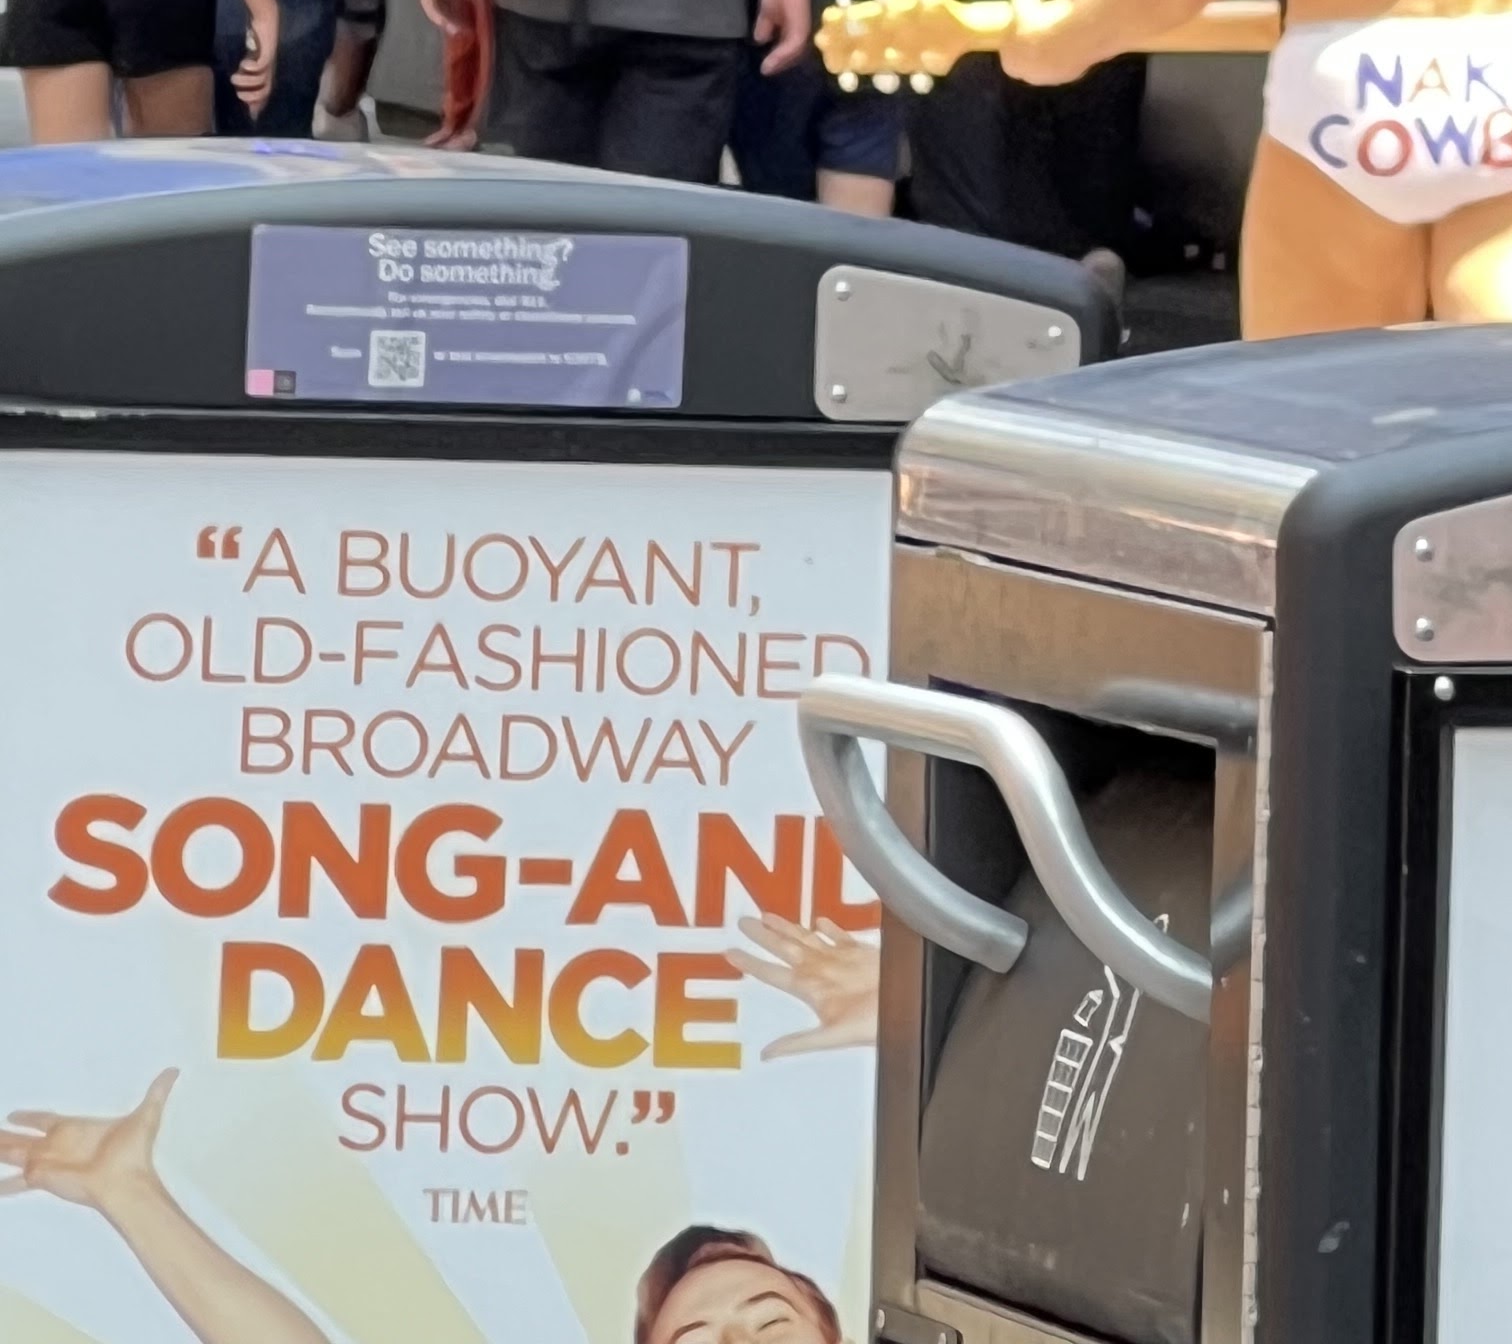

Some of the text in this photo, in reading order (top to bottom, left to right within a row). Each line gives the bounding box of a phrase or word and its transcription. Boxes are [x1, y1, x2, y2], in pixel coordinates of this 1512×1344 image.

[368, 232, 574, 266] See something?
[378, 258, 414, 282] Do
[337, 529, 762, 617] BUOYANT,
[125, 611, 872, 699] OLD-FASHIONED
[239, 705, 757, 786] BROADWAY
[216, 941, 744, 1070] DANCE
[338, 1082, 676, 1157] SHOW.”
[422, 1187, 529, 1226] TIME
